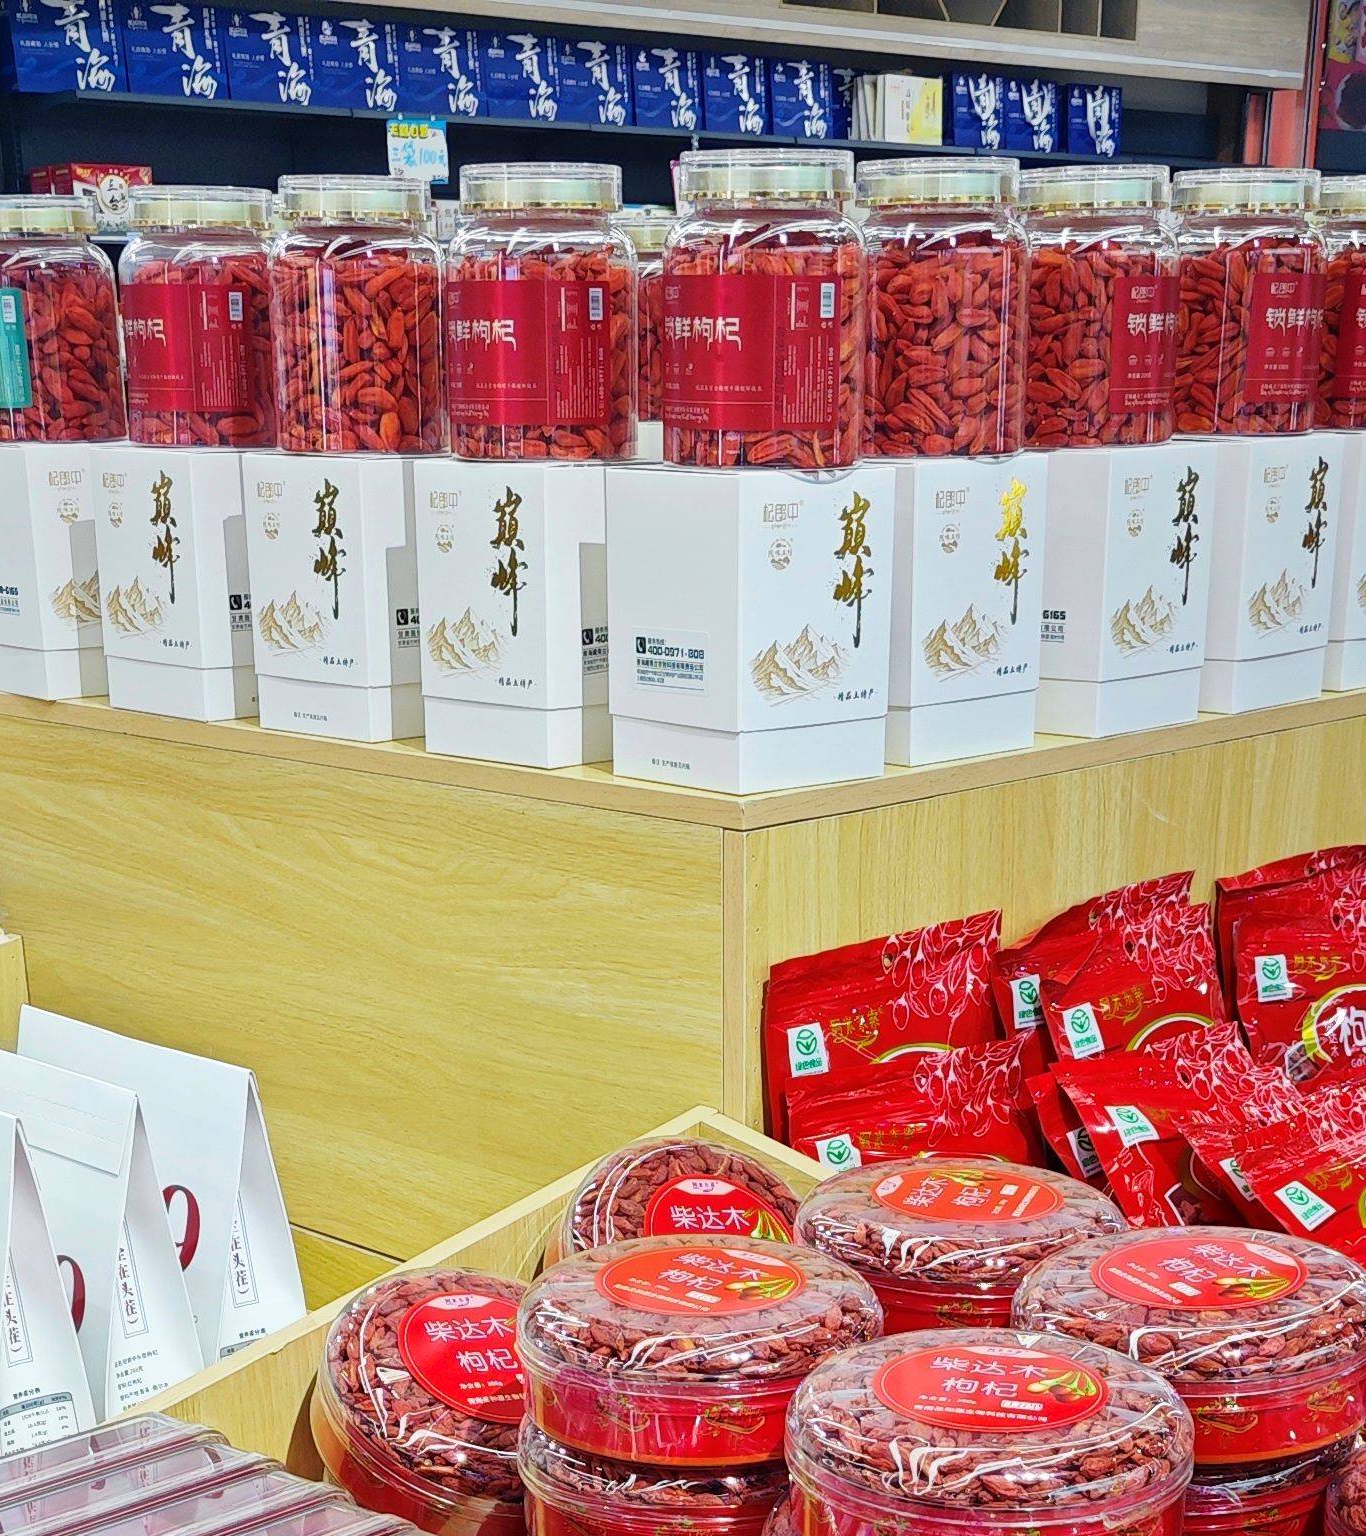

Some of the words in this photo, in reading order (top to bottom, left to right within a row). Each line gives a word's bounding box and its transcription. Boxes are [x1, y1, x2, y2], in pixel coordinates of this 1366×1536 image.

[41, 0, 116, 91] 青海
[149, 2, 217, 99] 青海
[248, 11, 312, 106] 青海
[339, 18, 398, 112] 青海
[423, 26, 479, 117] 青海
[507, 32, 558, 122] 青海
[577, 40, 627, 126] 青海
[651, 47, 698, 131] 青海
[721, 54, 764, 136] 青海
[786, 59, 828, 139] 青海
[763, 502, 799, 522] 杞郎中
[670, 1206, 751, 1231] 柴达木
[658, 1268, 723, 1294] 枸杞
[676, 1252, 767, 1282] 柴达木
[1157, 1257, 1216, 1284] 枸杞
[1188, 1243, 1272, 1278] 柴达木
[425, 1316, 515, 1344] 柴达木
[456, 1348, 520, 1375] 枸杞
[930, 1355, 1049, 1379] 柴达木
[941, 1377, 1020, 1398] 枸杞
